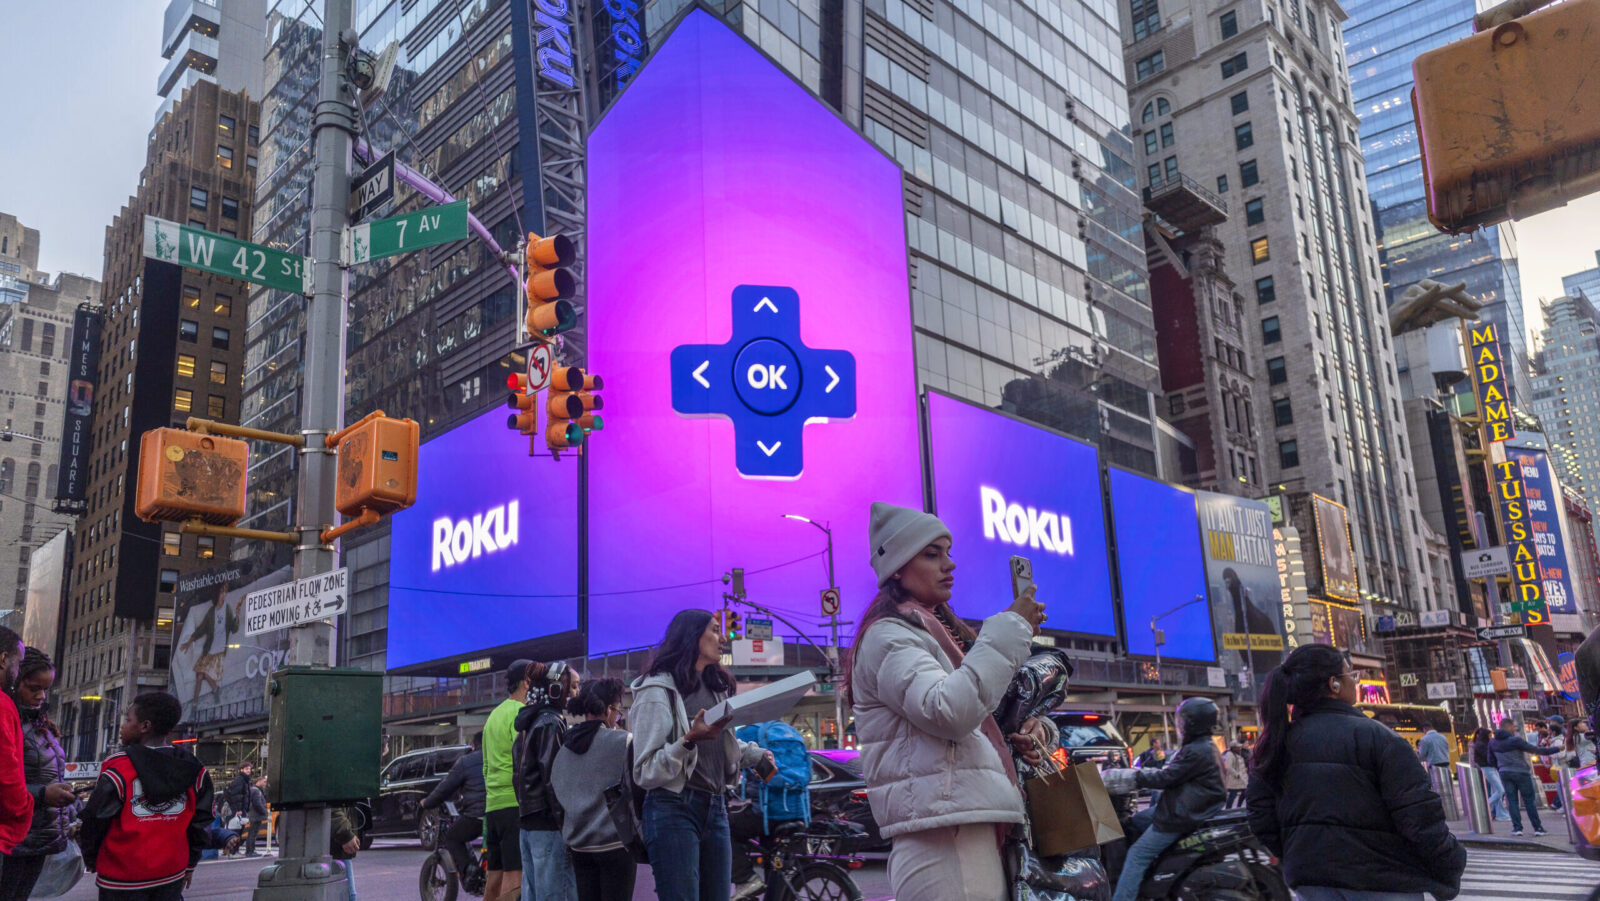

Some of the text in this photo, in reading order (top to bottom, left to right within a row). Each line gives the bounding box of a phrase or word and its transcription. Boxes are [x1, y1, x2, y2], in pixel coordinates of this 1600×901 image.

[358, 171, 383, 203] WAY
[396, 219, 408, 249] 7
[187, 232, 301, 281] W 42 St
[79, 316, 91, 377] TIMES
[747, 363, 788, 390] OK
[1471, 324, 1510, 442] MADAME
[68, 419, 83, 495] SQUARE
[1244, 507, 1268, 538] JUST
[1208, 529, 1273, 567] MANHATTAN
[1497, 460, 1543, 624] TUSSAUDS
[1535, 533, 1547, 546] AYS
[179, 568, 241, 593] Washable covers.
[247, 571, 345, 612] PEDESTRIAN FLOW ZONE
[1272, 528, 1299, 654] AMSTERDA
[247, 605, 300, 633] KEEP MOVING
[1503, 626, 1519, 635] WAY
[79, 762, 99, 772] NY
